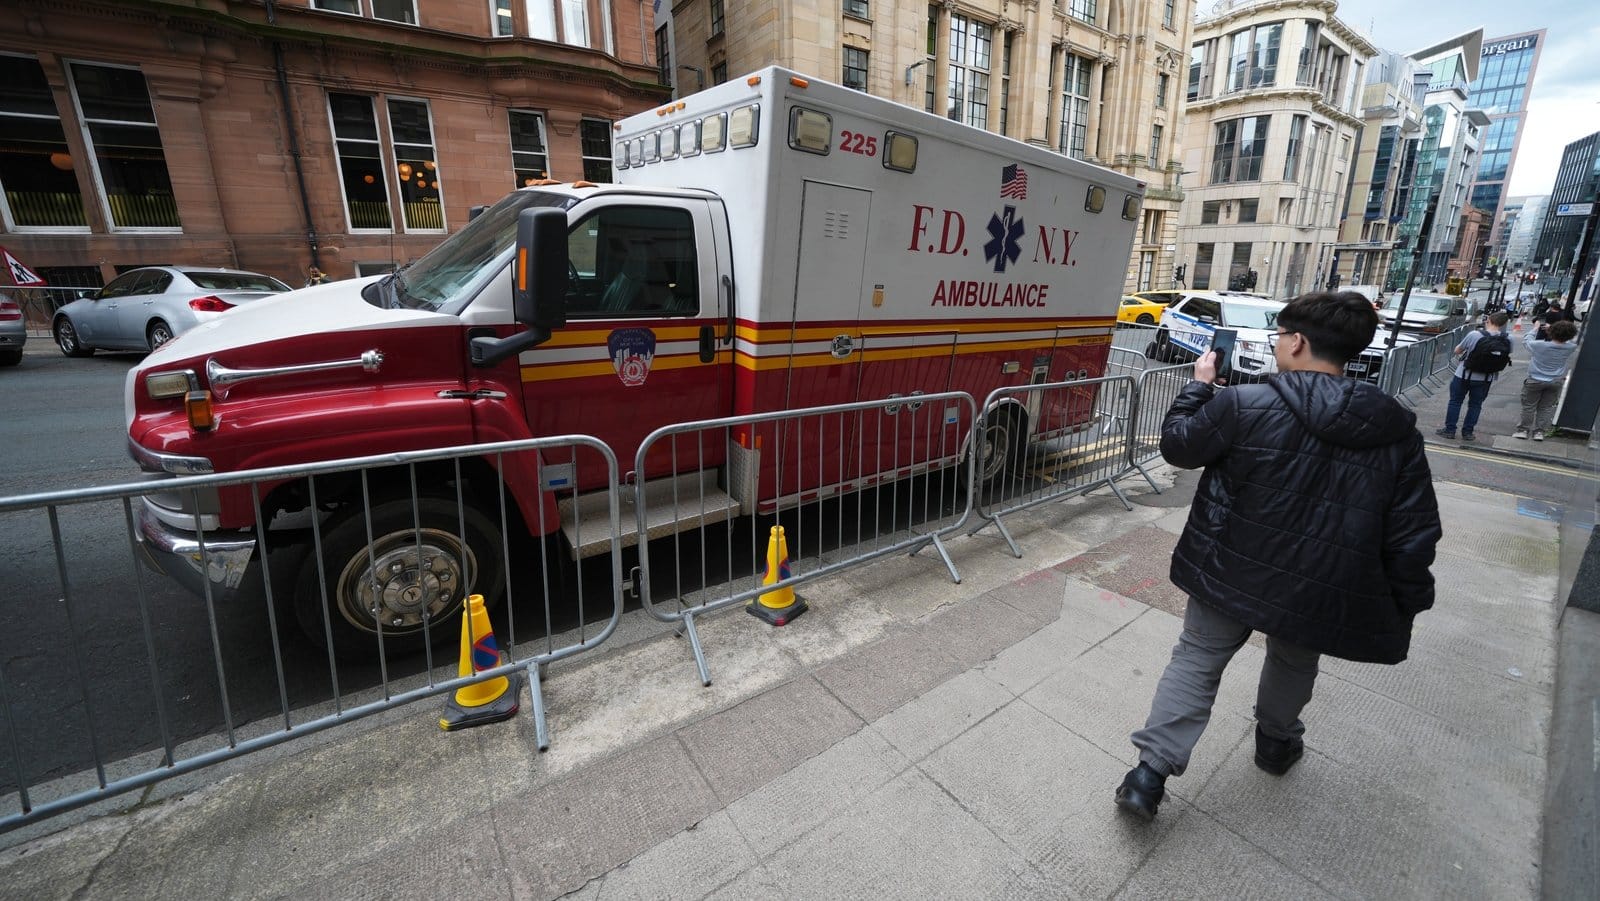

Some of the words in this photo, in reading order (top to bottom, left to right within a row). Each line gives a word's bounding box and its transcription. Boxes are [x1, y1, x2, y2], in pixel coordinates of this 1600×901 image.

[1482, 39, 1529, 56] organ
[840, 130, 877, 157] 225
[907, 204, 969, 257] F.D.
[1033, 225, 1079, 267] N.Y.
[931, 280, 1048, 308] AMBULANCE
[1189, 333, 1208, 346] NYPD
